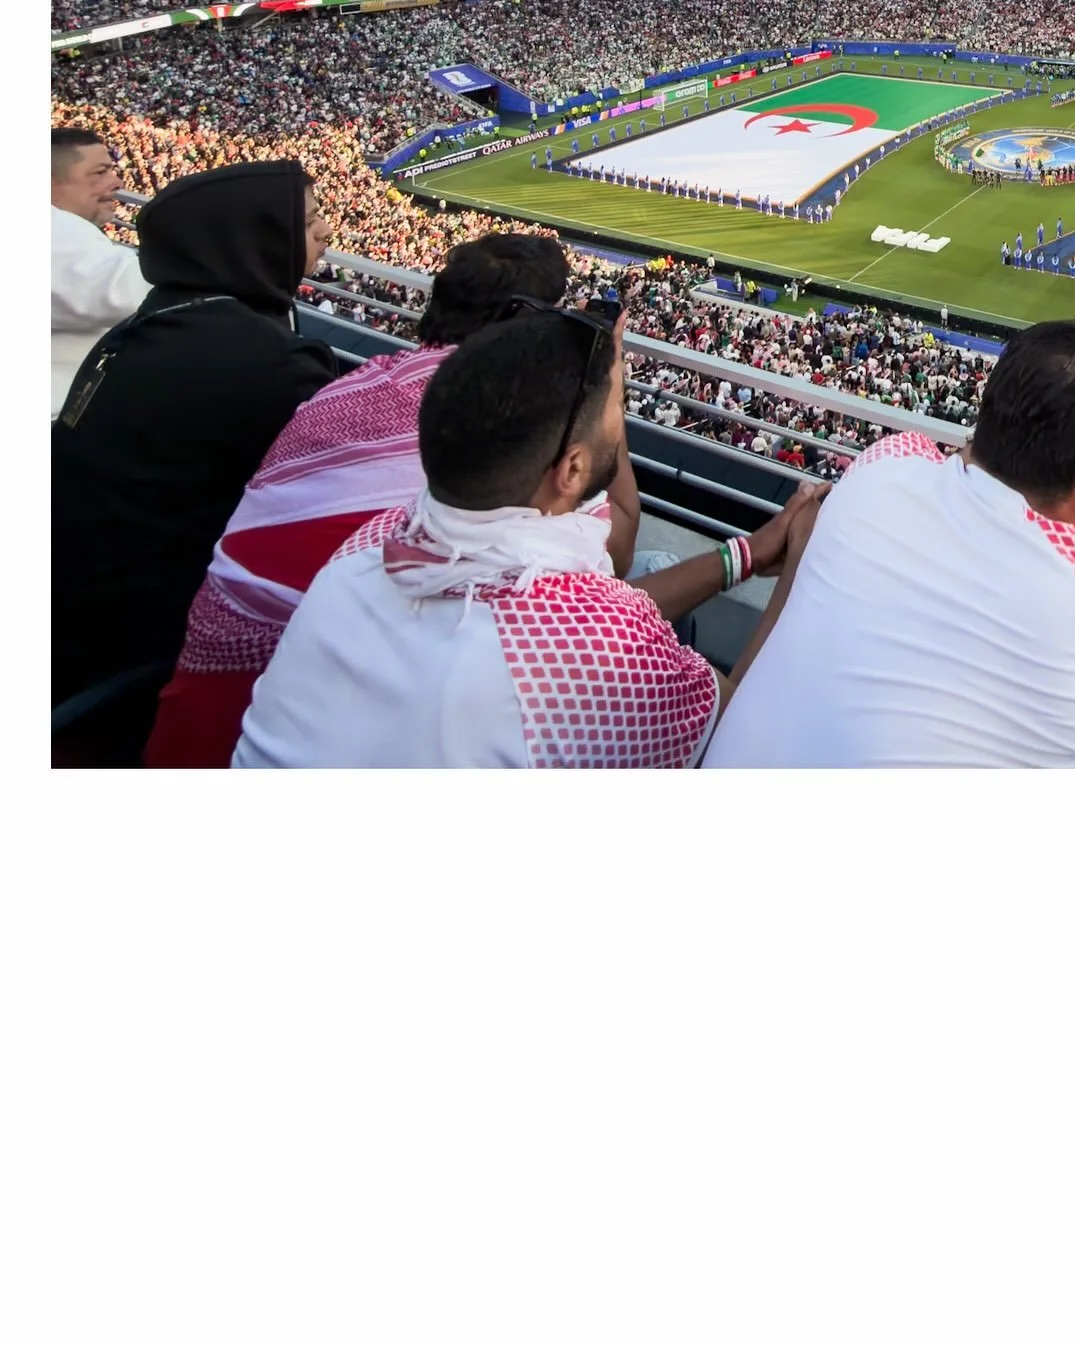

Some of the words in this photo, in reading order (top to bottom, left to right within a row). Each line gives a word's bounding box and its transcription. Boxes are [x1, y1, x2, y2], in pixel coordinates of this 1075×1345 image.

[572, 115, 592, 128] VISA
[482, 140, 512, 155] QATAR
[514, 129, 549, 145] AIRWAYS
[404, 166, 423, 178] ADI
